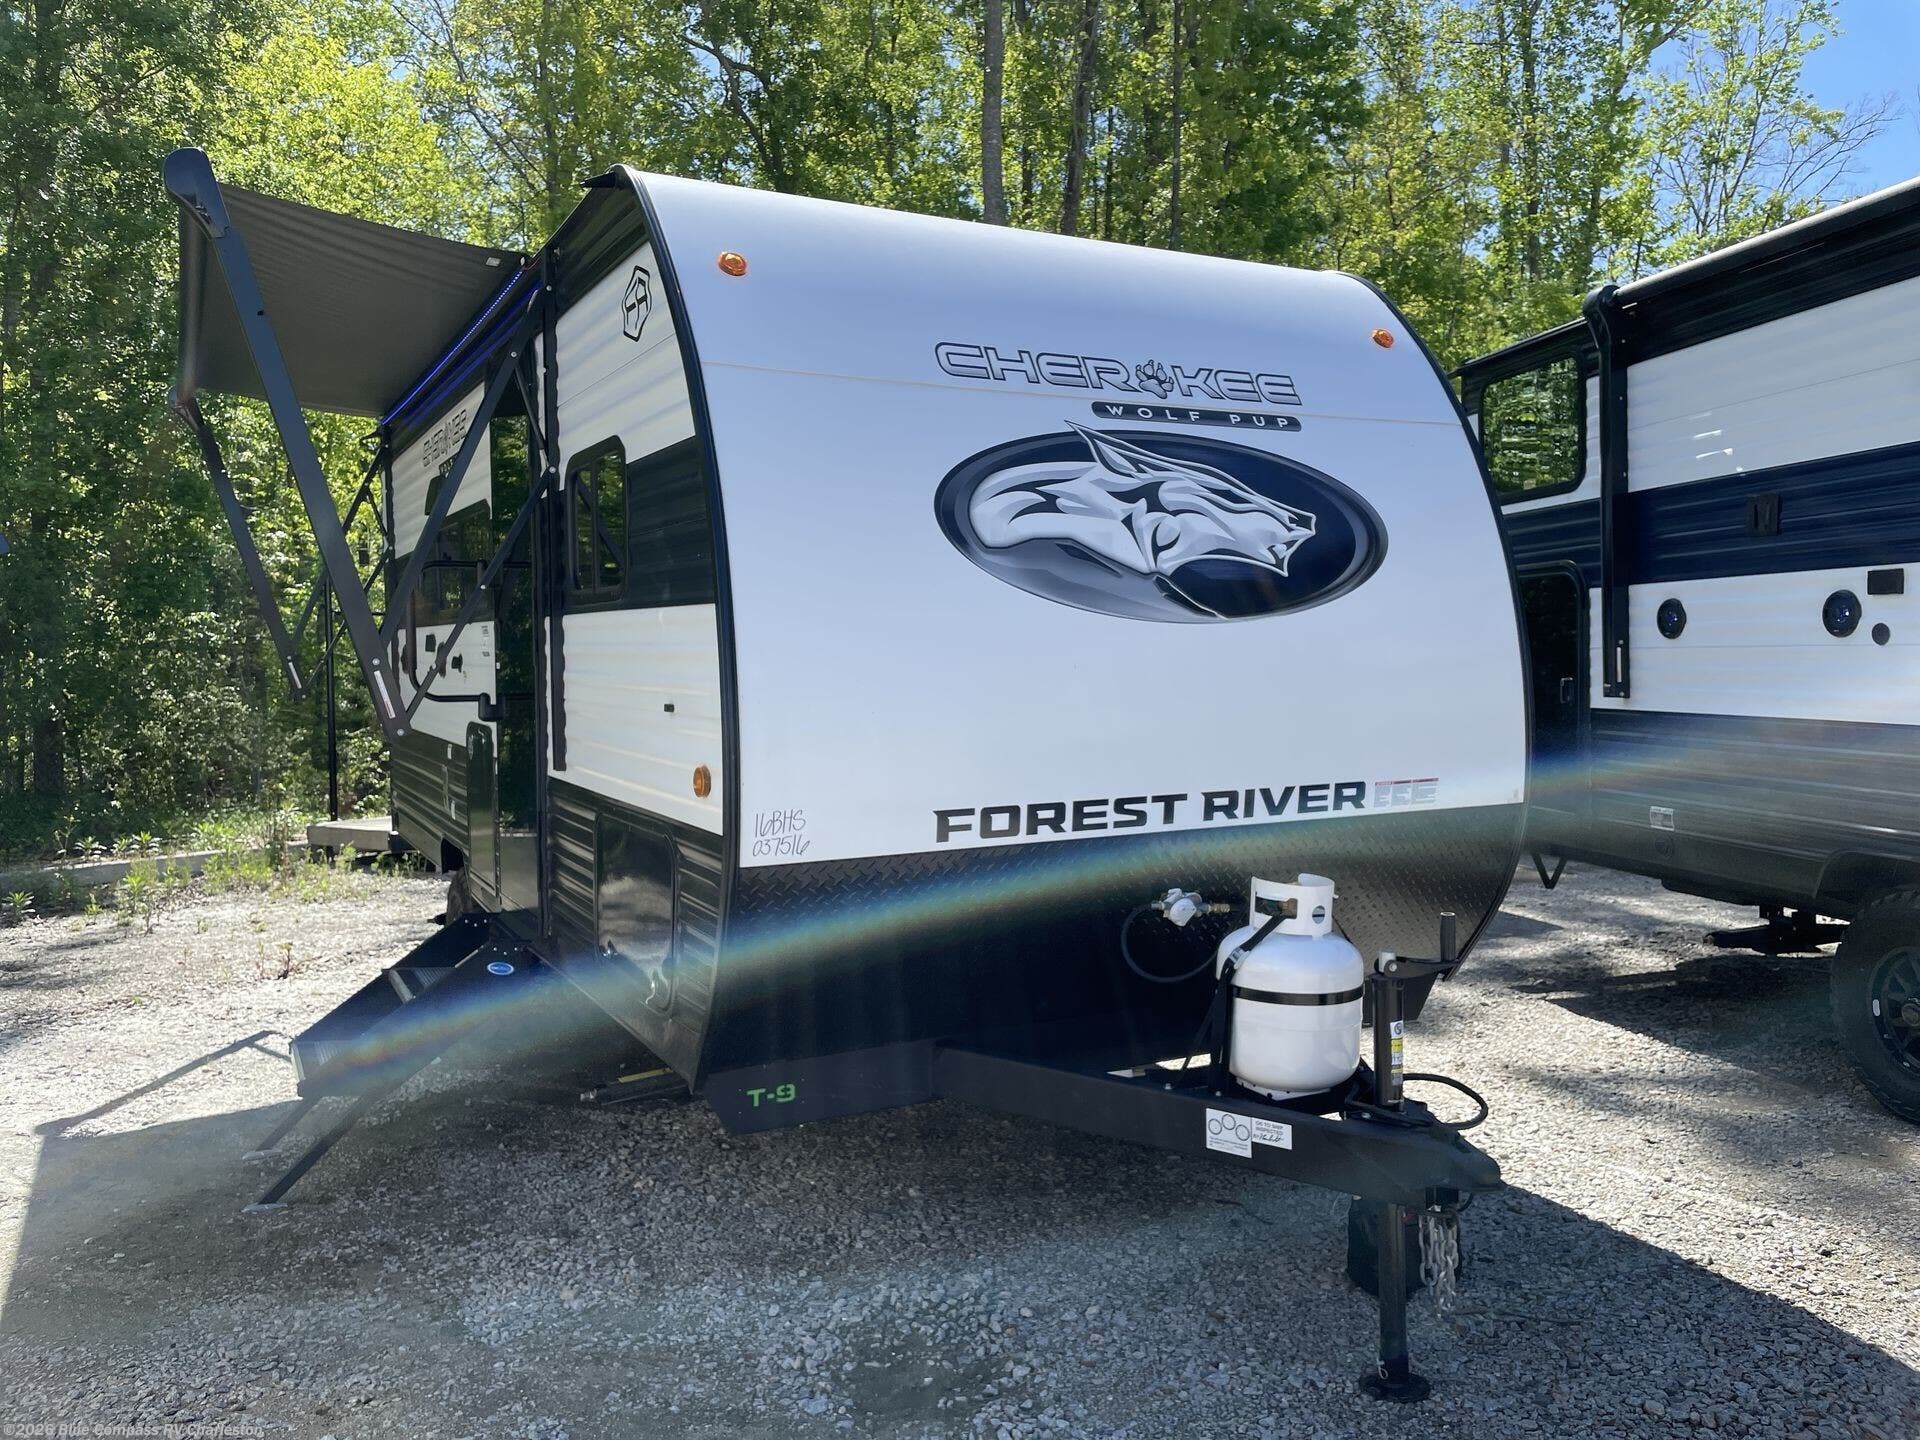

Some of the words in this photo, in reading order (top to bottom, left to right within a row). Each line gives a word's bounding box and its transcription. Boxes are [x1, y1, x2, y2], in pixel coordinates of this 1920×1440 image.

[1105, 404, 1200, 422] WOLF
[1229, 413, 1289, 428] PUP
[754, 808, 806, 838] 16BHS
[932, 793, 1188, 843] FOREST
[1201, 781, 1367, 821] RIVER
[752, 834, 811, 857] 037516
[746, 1083, 796, 1107] T-9
